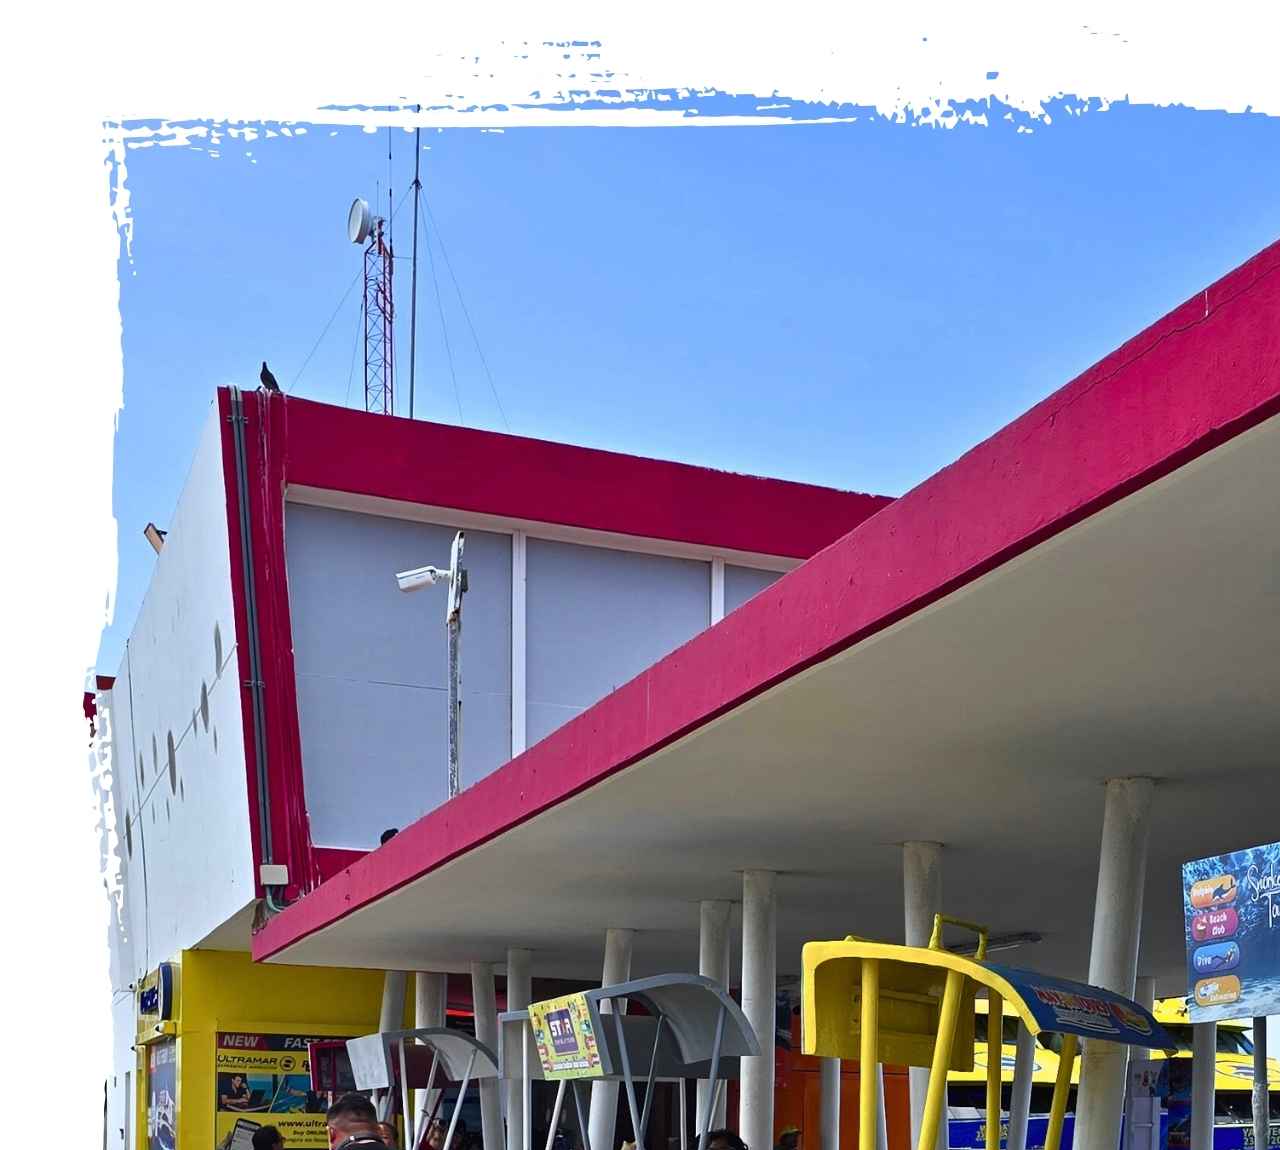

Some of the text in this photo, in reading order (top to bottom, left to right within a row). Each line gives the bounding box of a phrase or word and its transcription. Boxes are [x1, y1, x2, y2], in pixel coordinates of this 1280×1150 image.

[1197, 955, 1213, 967] Dive
[223, 1034, 258, 1048] NEW
[218, 1055, 278, 1065] ULTRAMAR
